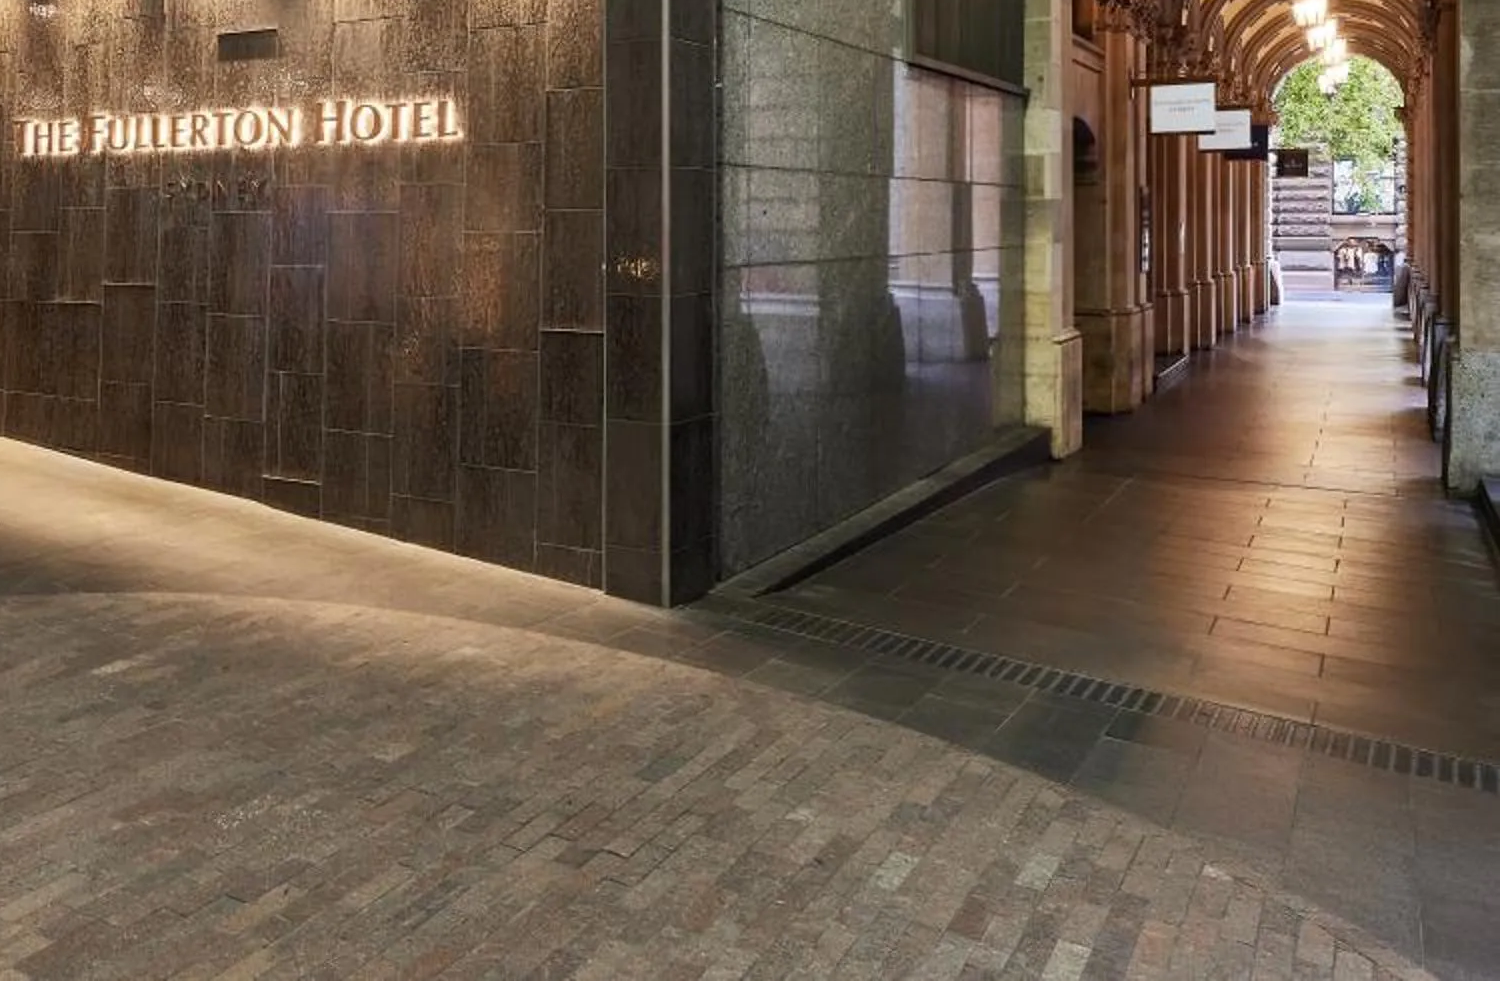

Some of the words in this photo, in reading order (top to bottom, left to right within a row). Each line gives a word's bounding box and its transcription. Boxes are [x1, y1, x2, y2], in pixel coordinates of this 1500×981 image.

[14, 118, 78, 155] THE
[82, 110, 298, 153] FULLERTON
[317, 99, 462, 144] HOTEL
